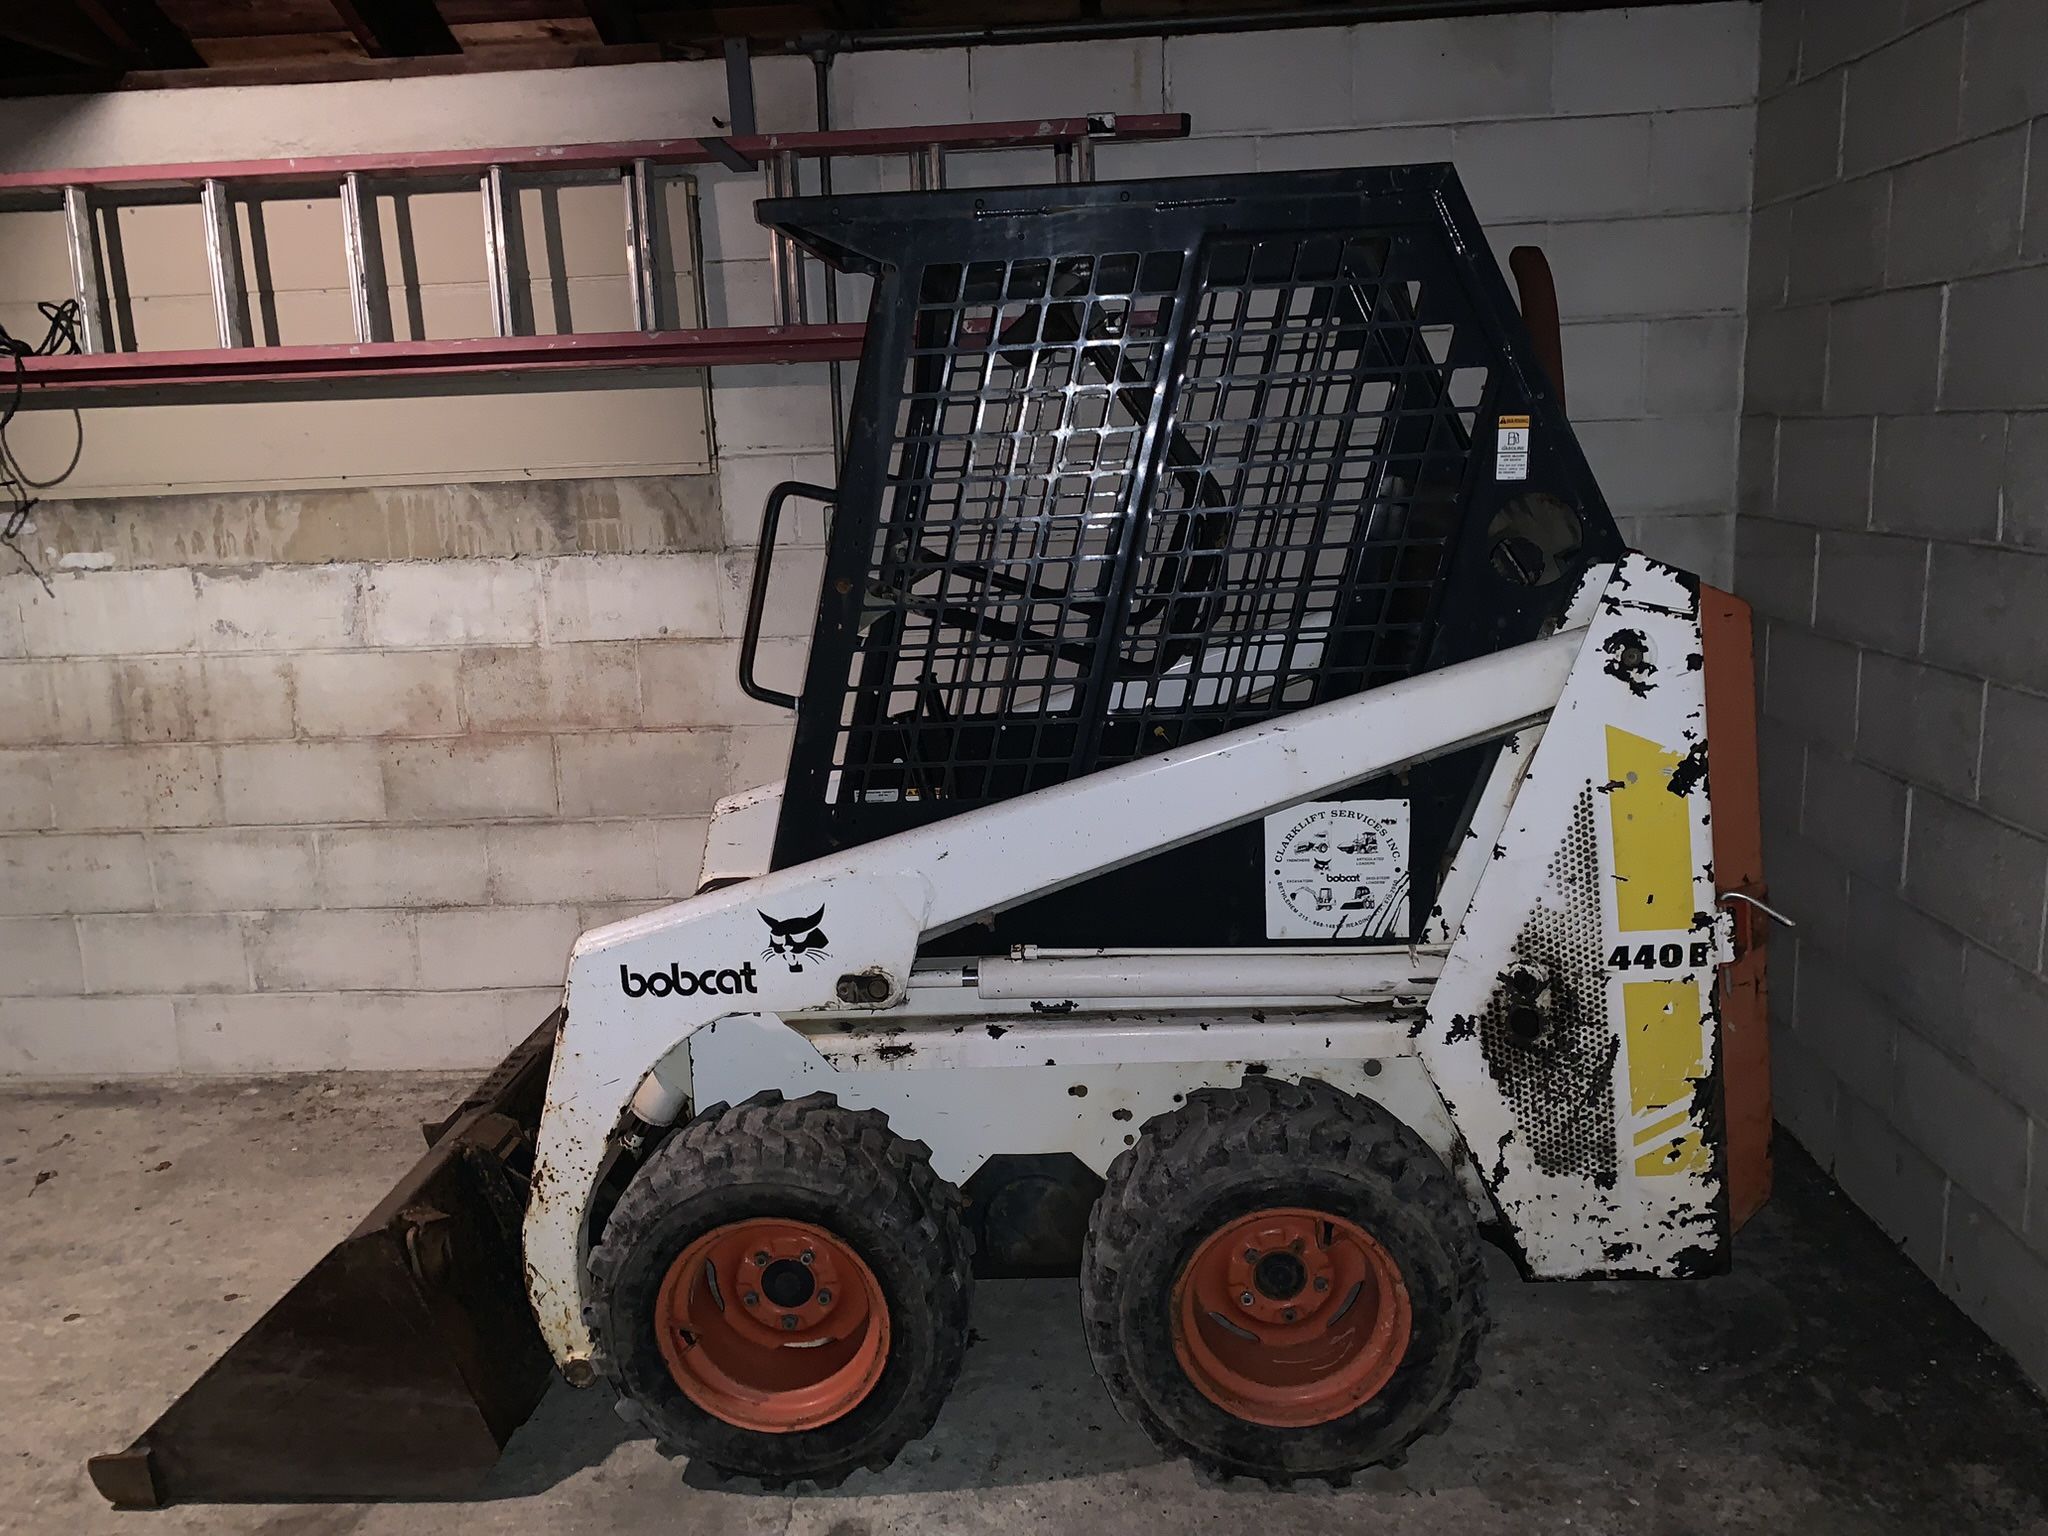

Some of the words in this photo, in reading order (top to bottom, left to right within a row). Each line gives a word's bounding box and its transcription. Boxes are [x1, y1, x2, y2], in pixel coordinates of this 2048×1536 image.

[1275, 811, 1326, 863] CLARKLIFT
[1330, 809, 1388, 837] SERVICES
[1386, 838, 1400, 862] INC.
[1326, 873, 1361, 882] bobcat
[1277, 881, 1299, 914] BETHLEHEM
[620, 961, 758, 998] bobcat
